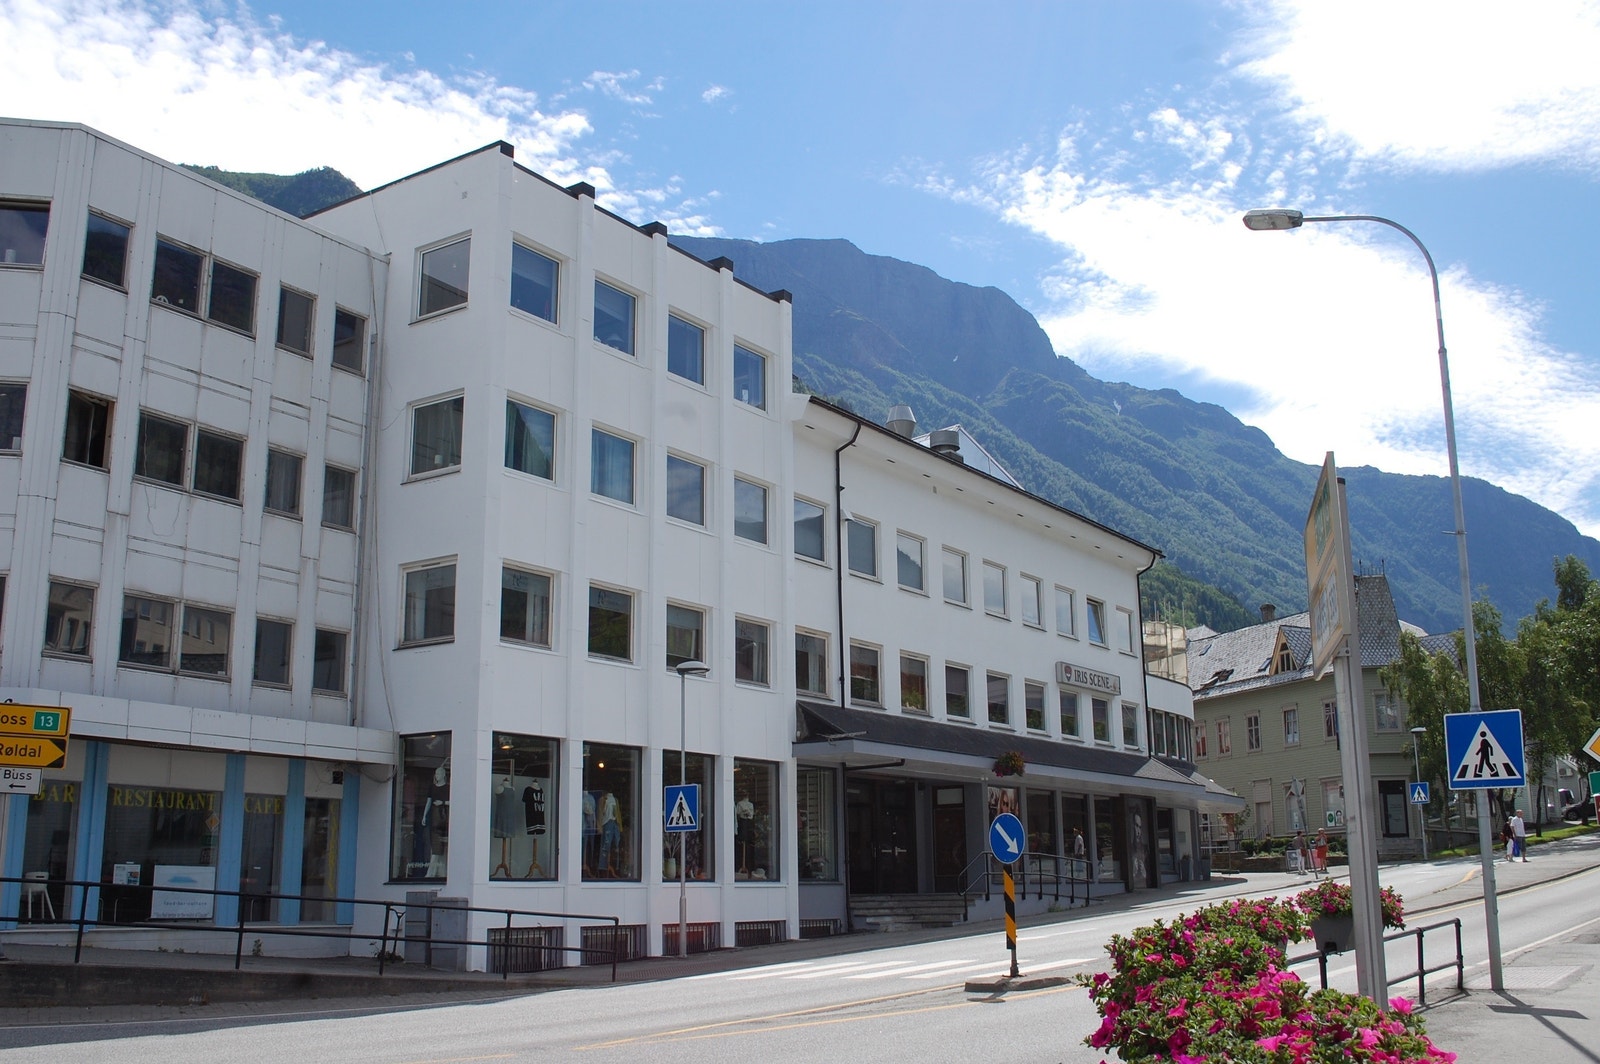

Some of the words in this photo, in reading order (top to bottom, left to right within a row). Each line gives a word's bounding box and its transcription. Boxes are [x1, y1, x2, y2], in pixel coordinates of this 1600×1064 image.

[1074, 669, 1088, 684] IRIS
[1089, 673, 1110, 689] SCENE
[0, 712, 27, 726] oss
[40, 716, 54, 727] 13
[4, 769, 33, 780] Buss
[113, 788, 216, 811] RESTAURANT
